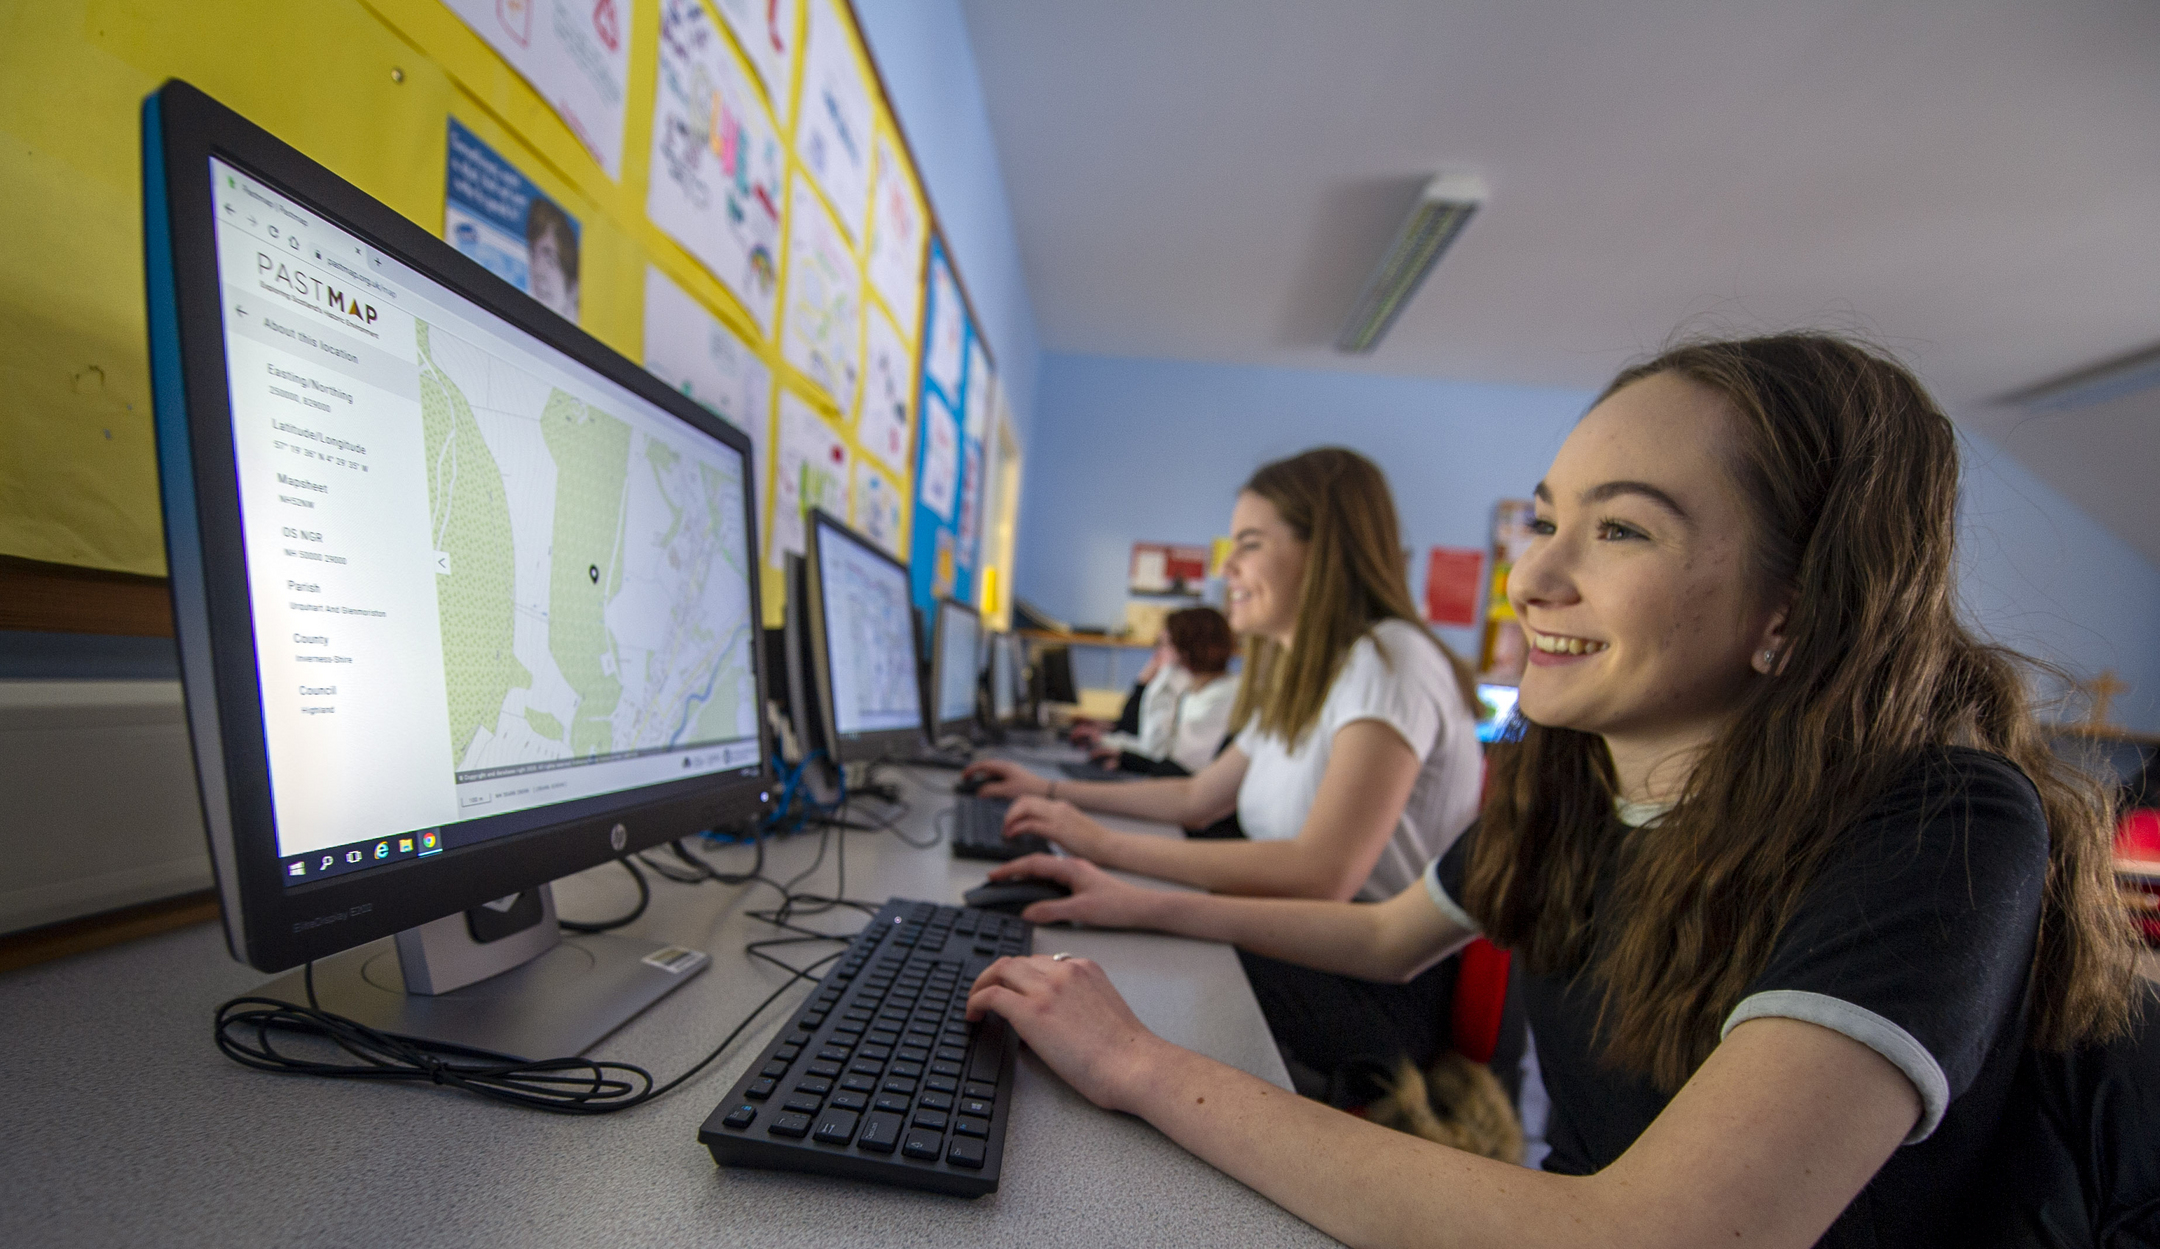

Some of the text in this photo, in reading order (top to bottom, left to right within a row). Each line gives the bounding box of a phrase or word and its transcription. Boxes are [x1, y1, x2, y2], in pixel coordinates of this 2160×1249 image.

[257, 252, 378, 324] PASTMAP
[263, 318, 359, 364] About this location
[267, 363, 353, 404] Easting/Northing
[271, 418, 367, 455] Latitude/Longitude
[277, 472, 329, 494] Mapsheet
[282, 526, 323, 543] OS NGR
[287, 580, 321, 593] Parish
[293, 633, 329, 646] County
[299, 685, 337, 695] Council
[301, 706, 335, 715] Highland
